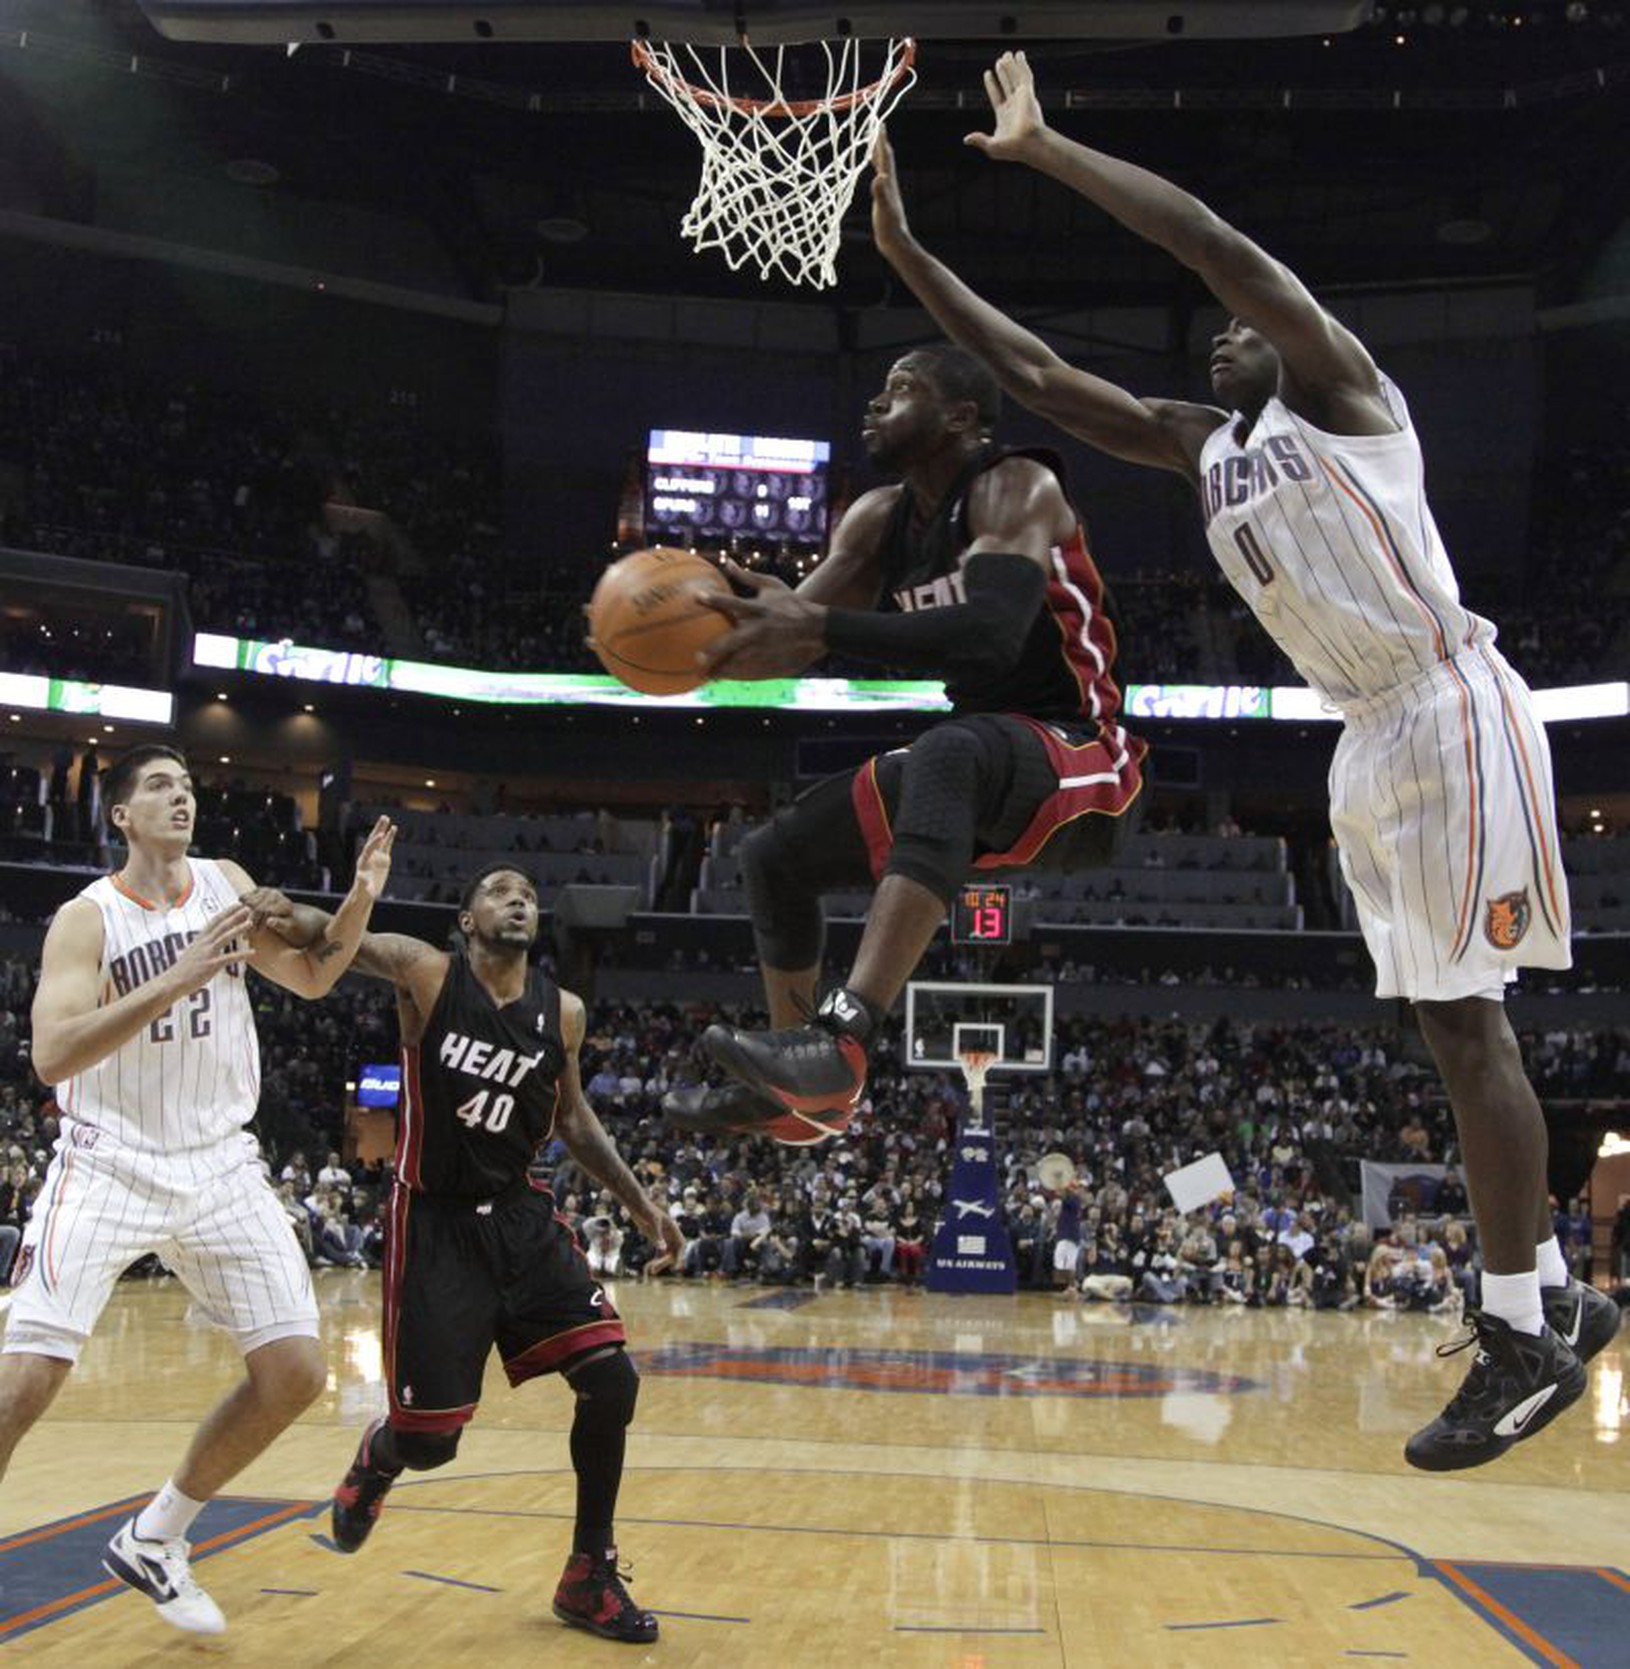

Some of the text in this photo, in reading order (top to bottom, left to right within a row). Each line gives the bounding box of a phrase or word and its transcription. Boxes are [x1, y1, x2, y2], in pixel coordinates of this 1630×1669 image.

[1233, 521, 1275, 587] 0
[974, 908, 1002, 938] 13
[151, 987, 211, 1043] 22
[440, 1031, 545, 1088] HEAT
[456, 1090, 515, 1133] 40
